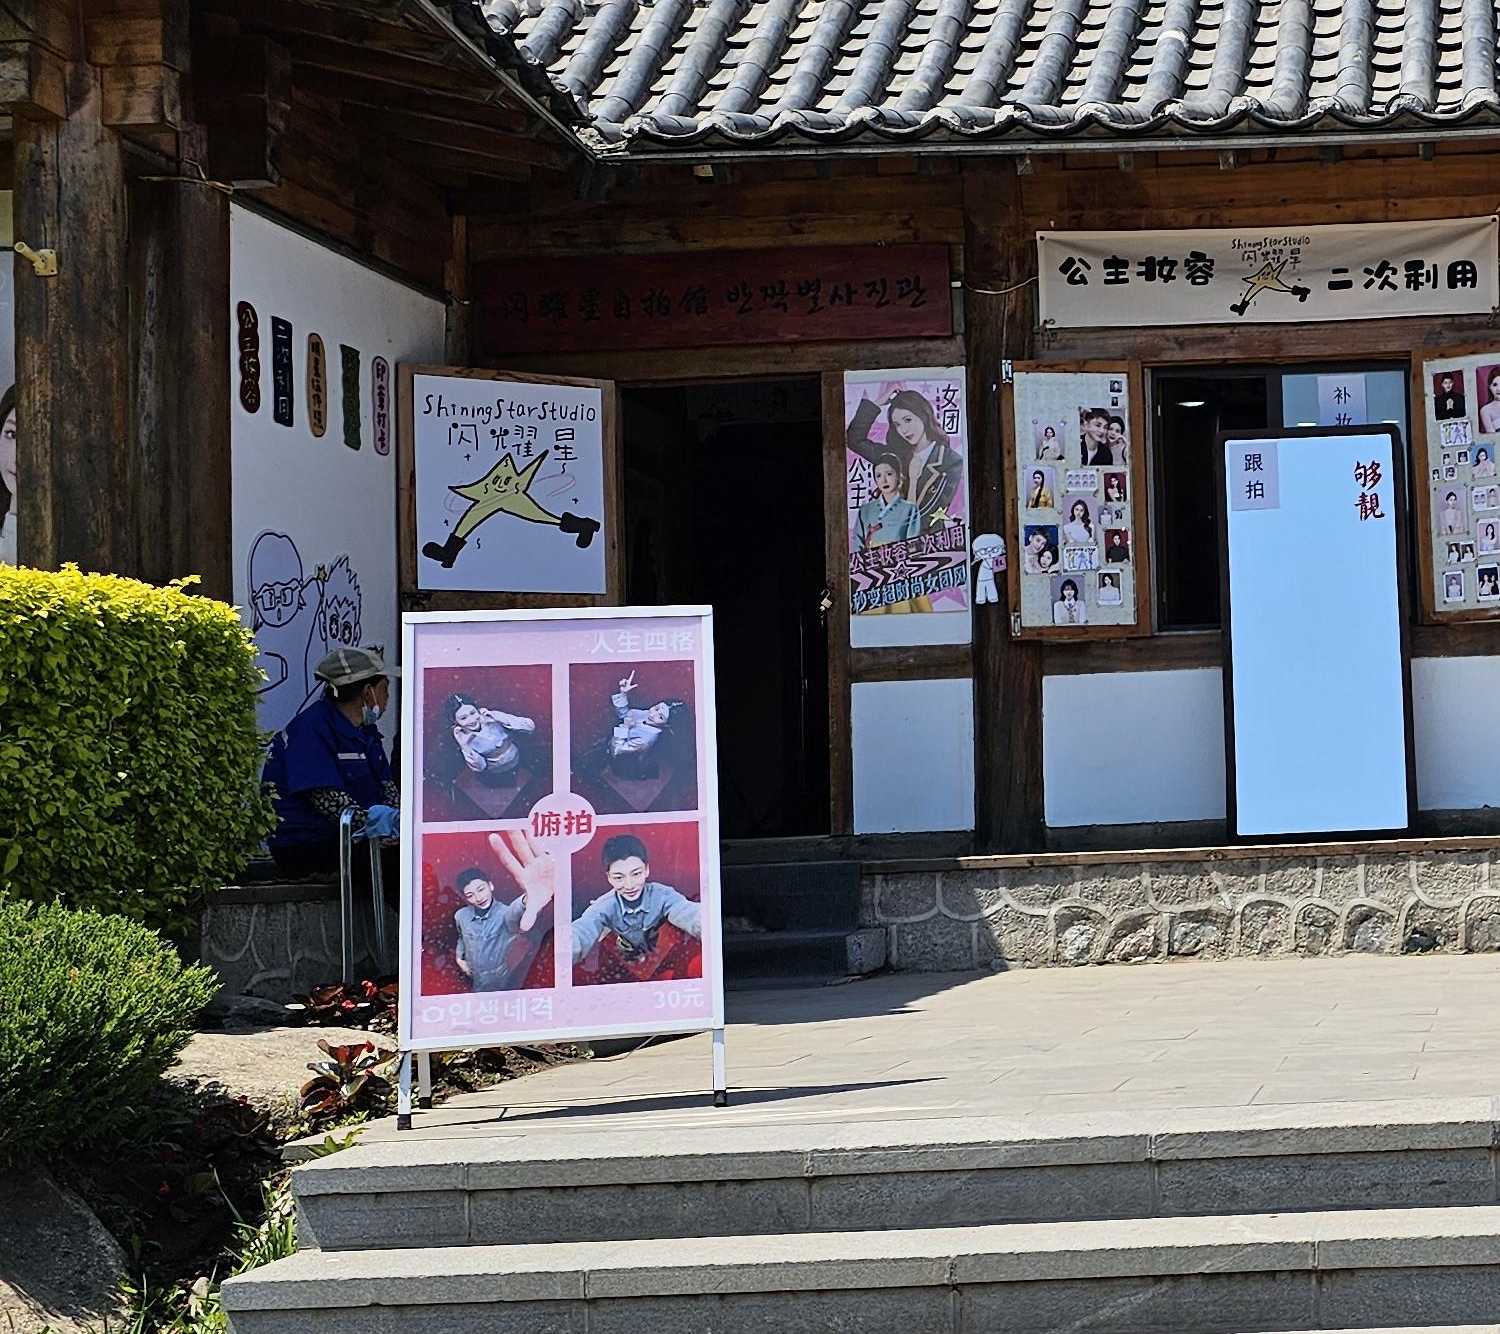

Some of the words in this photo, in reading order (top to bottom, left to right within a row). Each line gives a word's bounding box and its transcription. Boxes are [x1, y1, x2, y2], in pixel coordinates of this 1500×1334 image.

[1058, 250, 1215, 287] 公主妆容
[1327, 258, 1479, 292] 二次利用
[941, 383, 960, 435] 女团
[848, 458, 867, 510] 公主
[1243, 453, 1266, 500] 跟拍
[590, 630, 695, 654] 人生四格
[531, 809, 593, 838] 俯拍
[653, 987, 705, 1009] 30元
